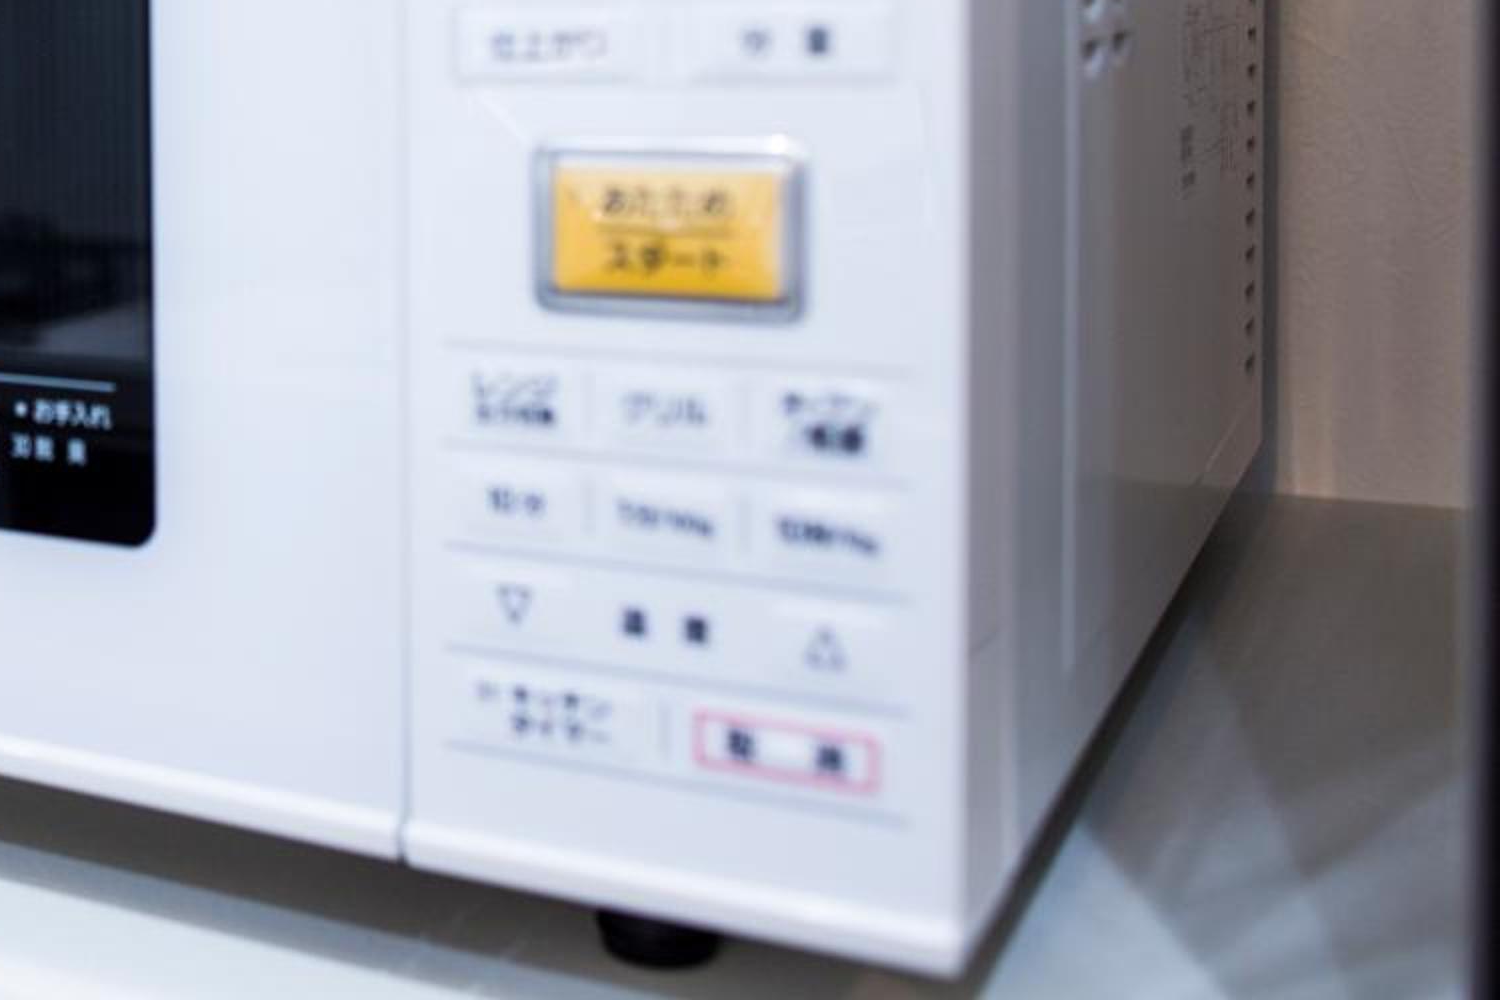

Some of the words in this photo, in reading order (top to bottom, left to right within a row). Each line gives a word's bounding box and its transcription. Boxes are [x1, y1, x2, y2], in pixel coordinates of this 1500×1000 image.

[603, 185, 735, 220] あたため
[605, 240, 731, 276] スタート
